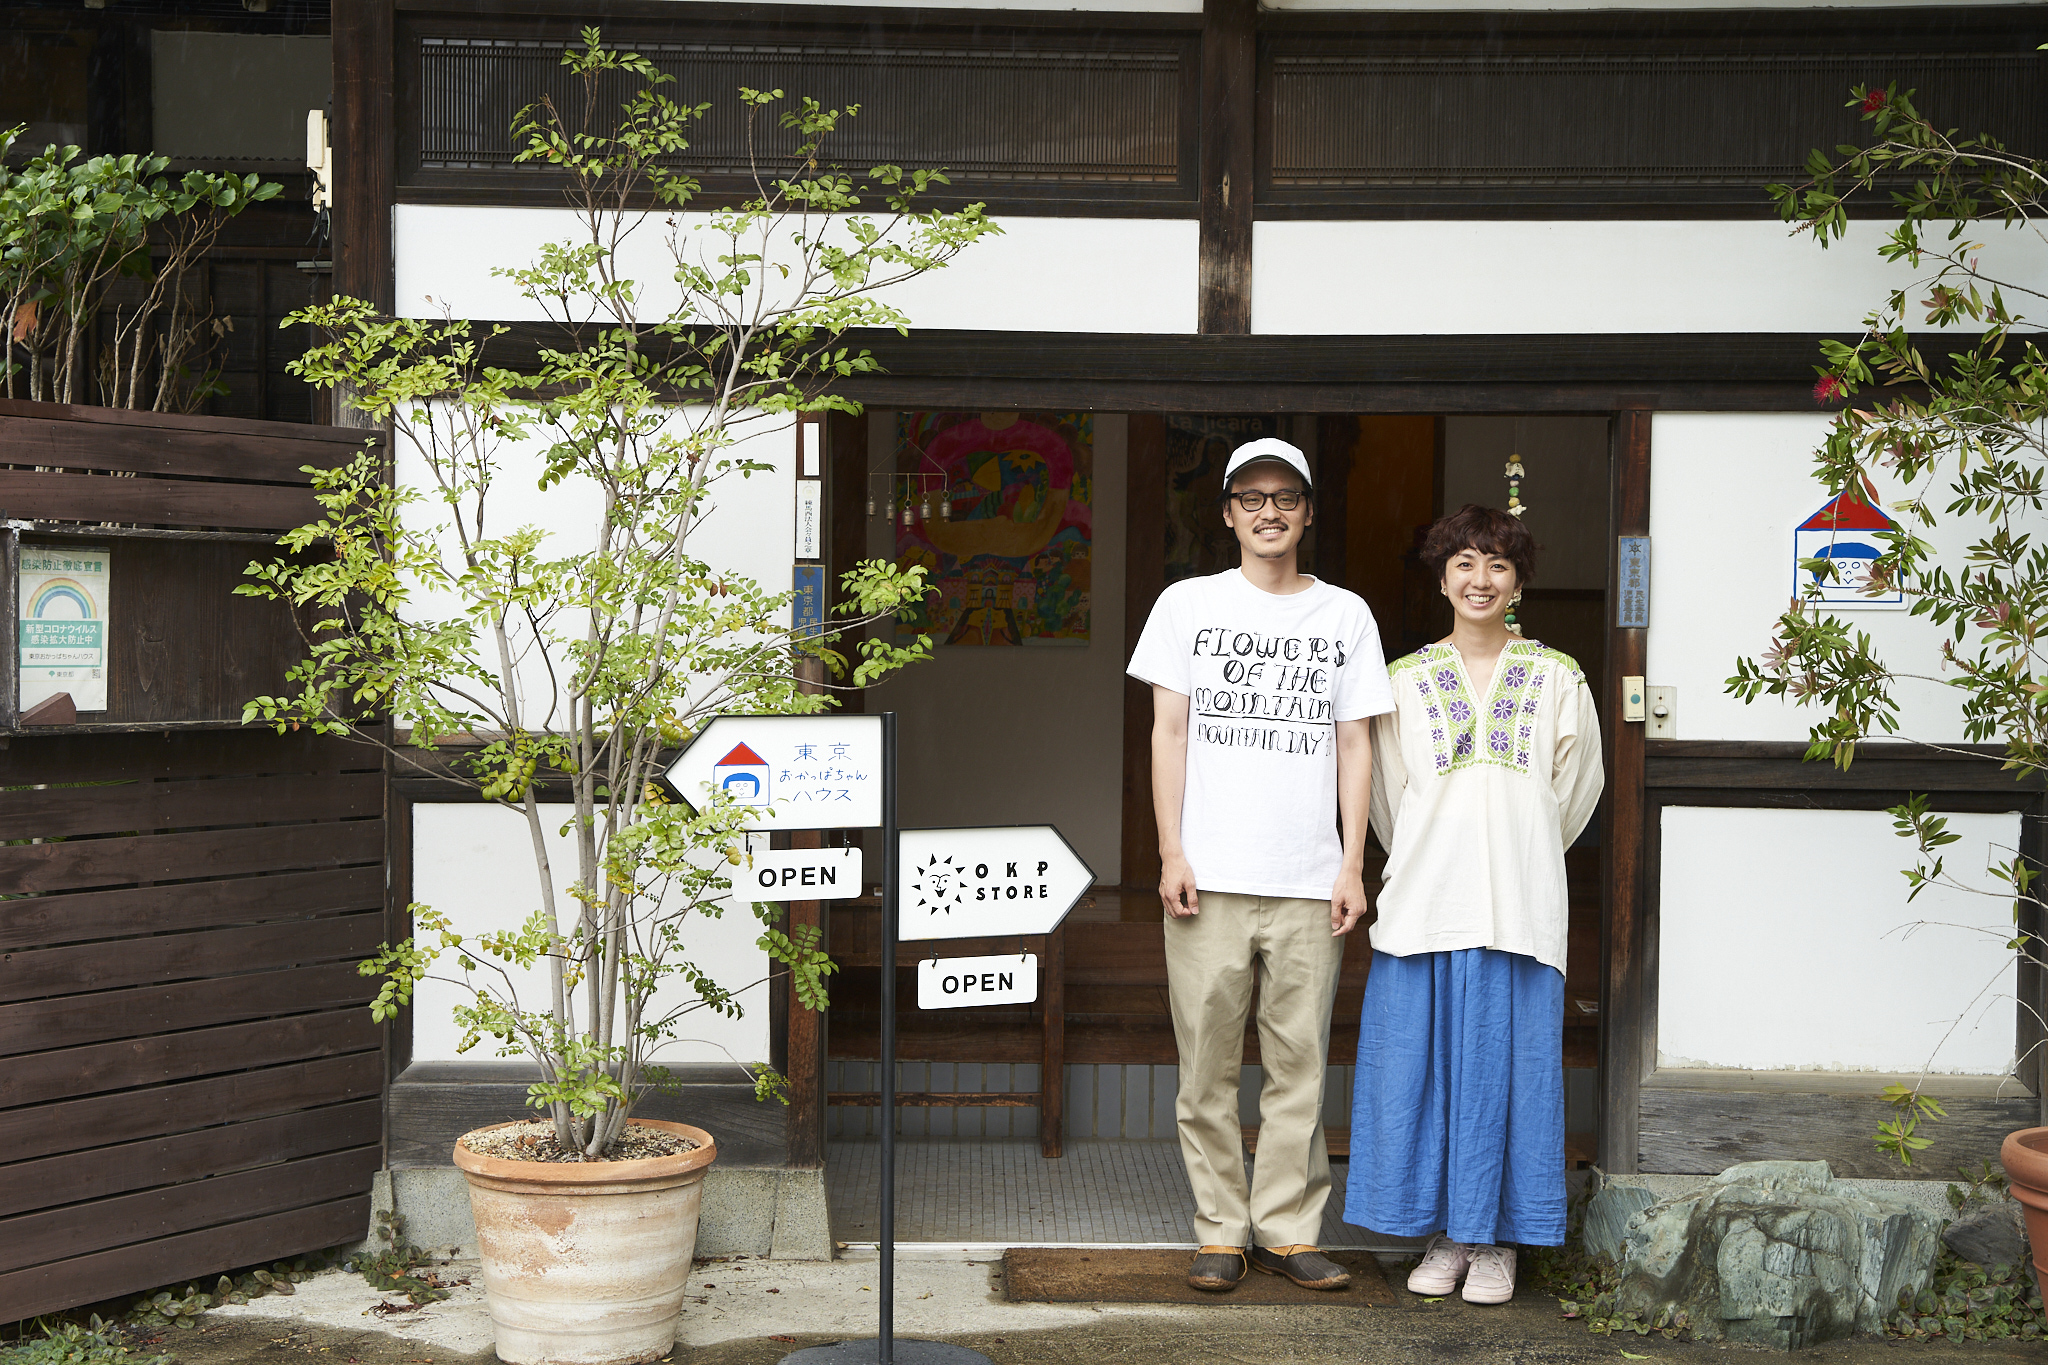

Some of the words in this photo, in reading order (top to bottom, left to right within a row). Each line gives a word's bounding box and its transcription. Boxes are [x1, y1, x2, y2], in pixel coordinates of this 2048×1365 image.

[20, 558, 103, 573] 感染防止徹底宣言
[802, 584, 815, 617] 東京都
[25, 623, 98, 634] 新型コロナウイルス
[30, 634, 94, 645] 感染拡大防止中
[1193, 628, 1347, 668] FLOWERS
[28, 652, 95, 661] 東京おかっぱちゃんハウス
[56, 670, 75, 678] 東京都
[1223, 659, 1267, 688] OF
[1273, 664, 1328, 694] THE
[1285, 730, 1325, 756] DAY
[779, 766, 868, 782] おかっぱちゃん
[792, 787, 852, 802] ハウス
[758, 866, 837, 888] OPEN
[975, 884, 1048, 901] STORE
[941, 972, 1014, 995] OPEN
